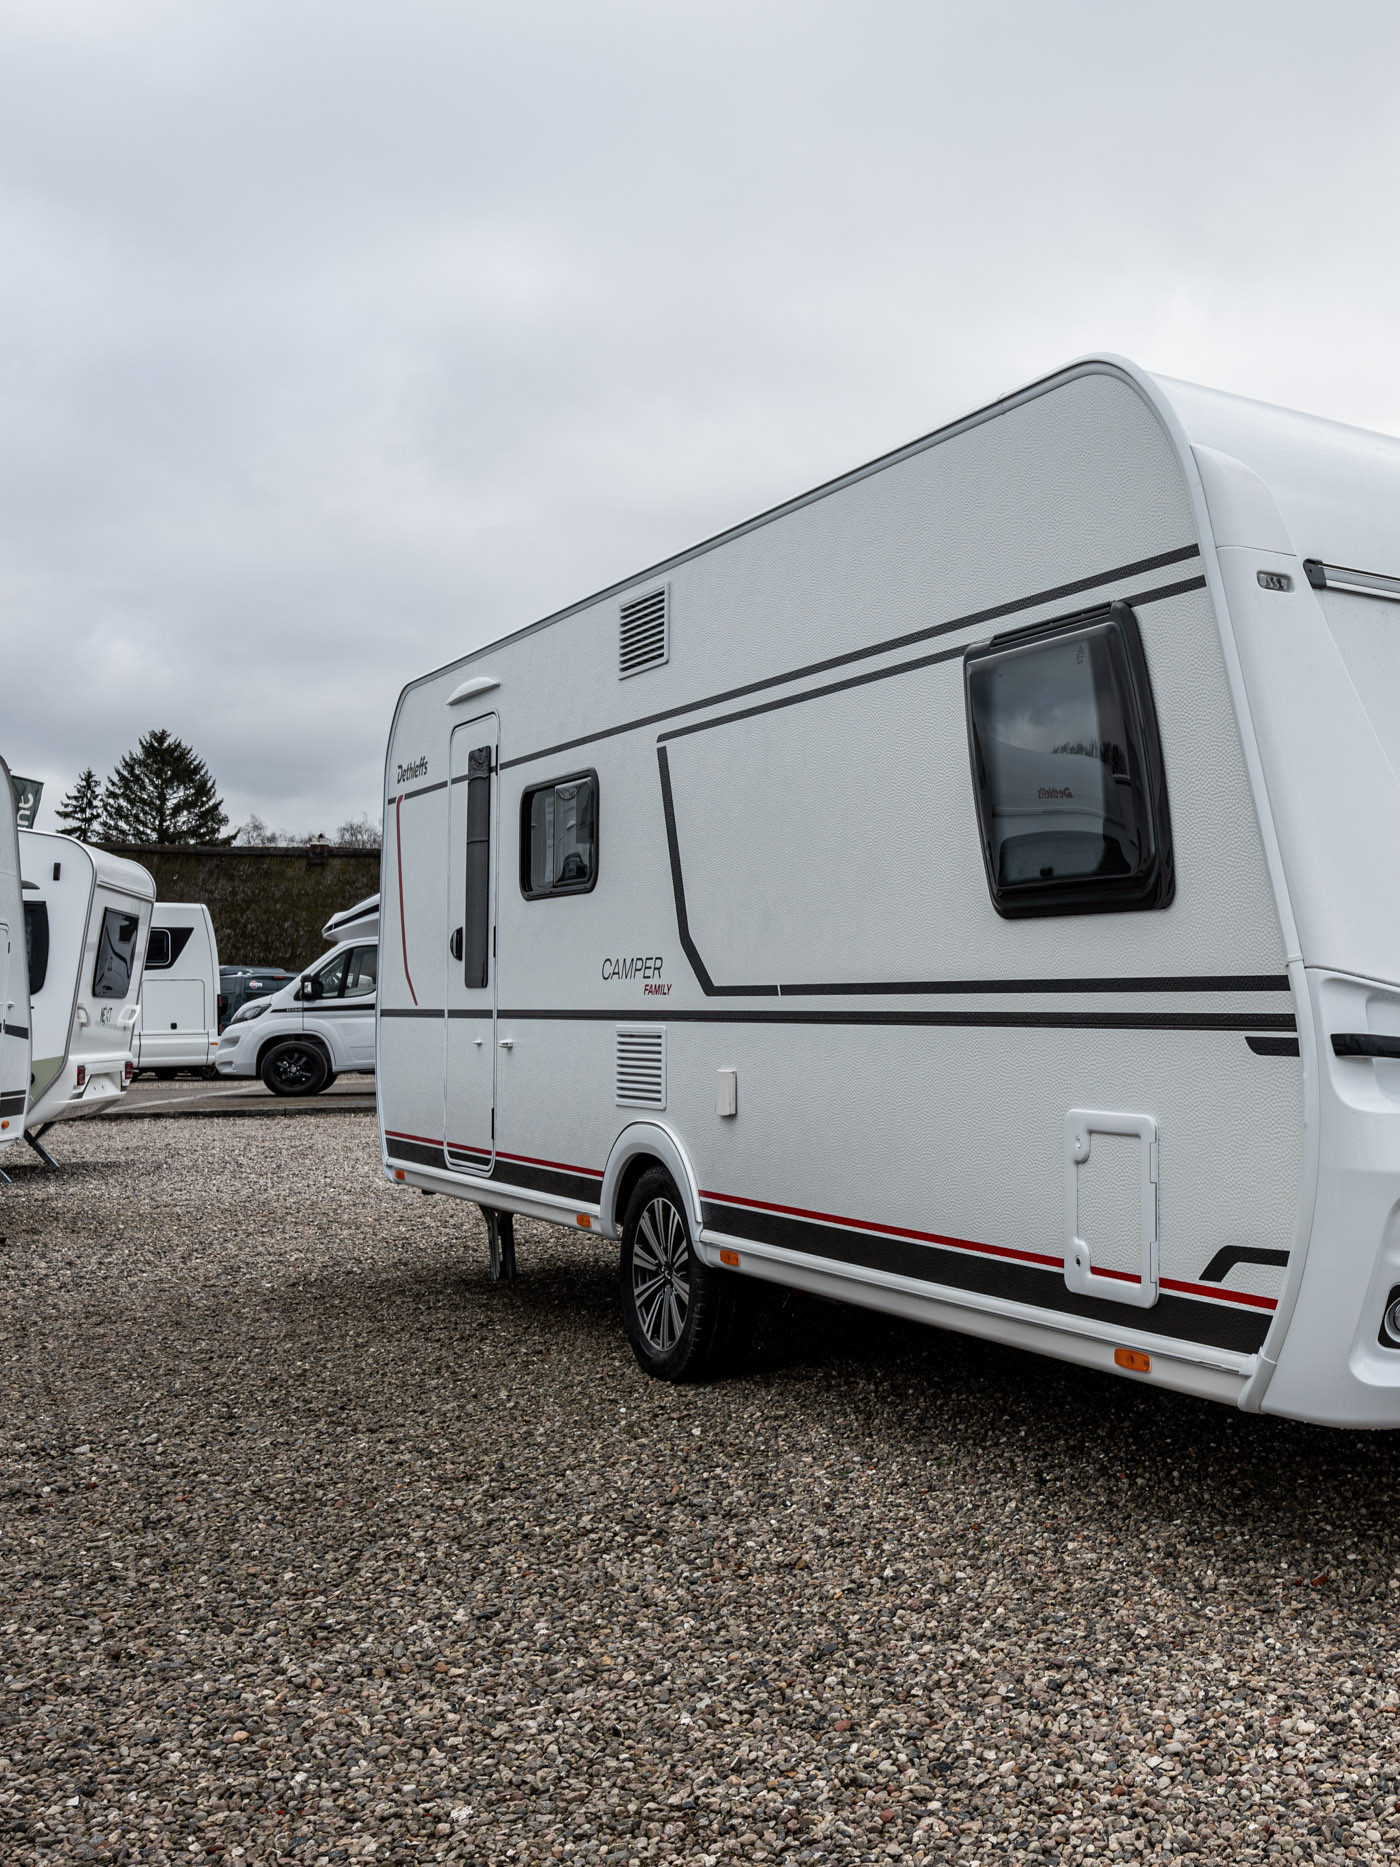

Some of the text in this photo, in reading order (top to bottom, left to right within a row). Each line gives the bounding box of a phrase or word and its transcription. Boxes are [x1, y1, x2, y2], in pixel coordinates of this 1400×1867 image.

[397, 756, 428, 784] Dethleffs
[601, 957, 664, 981] CAMPER
[643, 984, 673, 996] FAMILY
